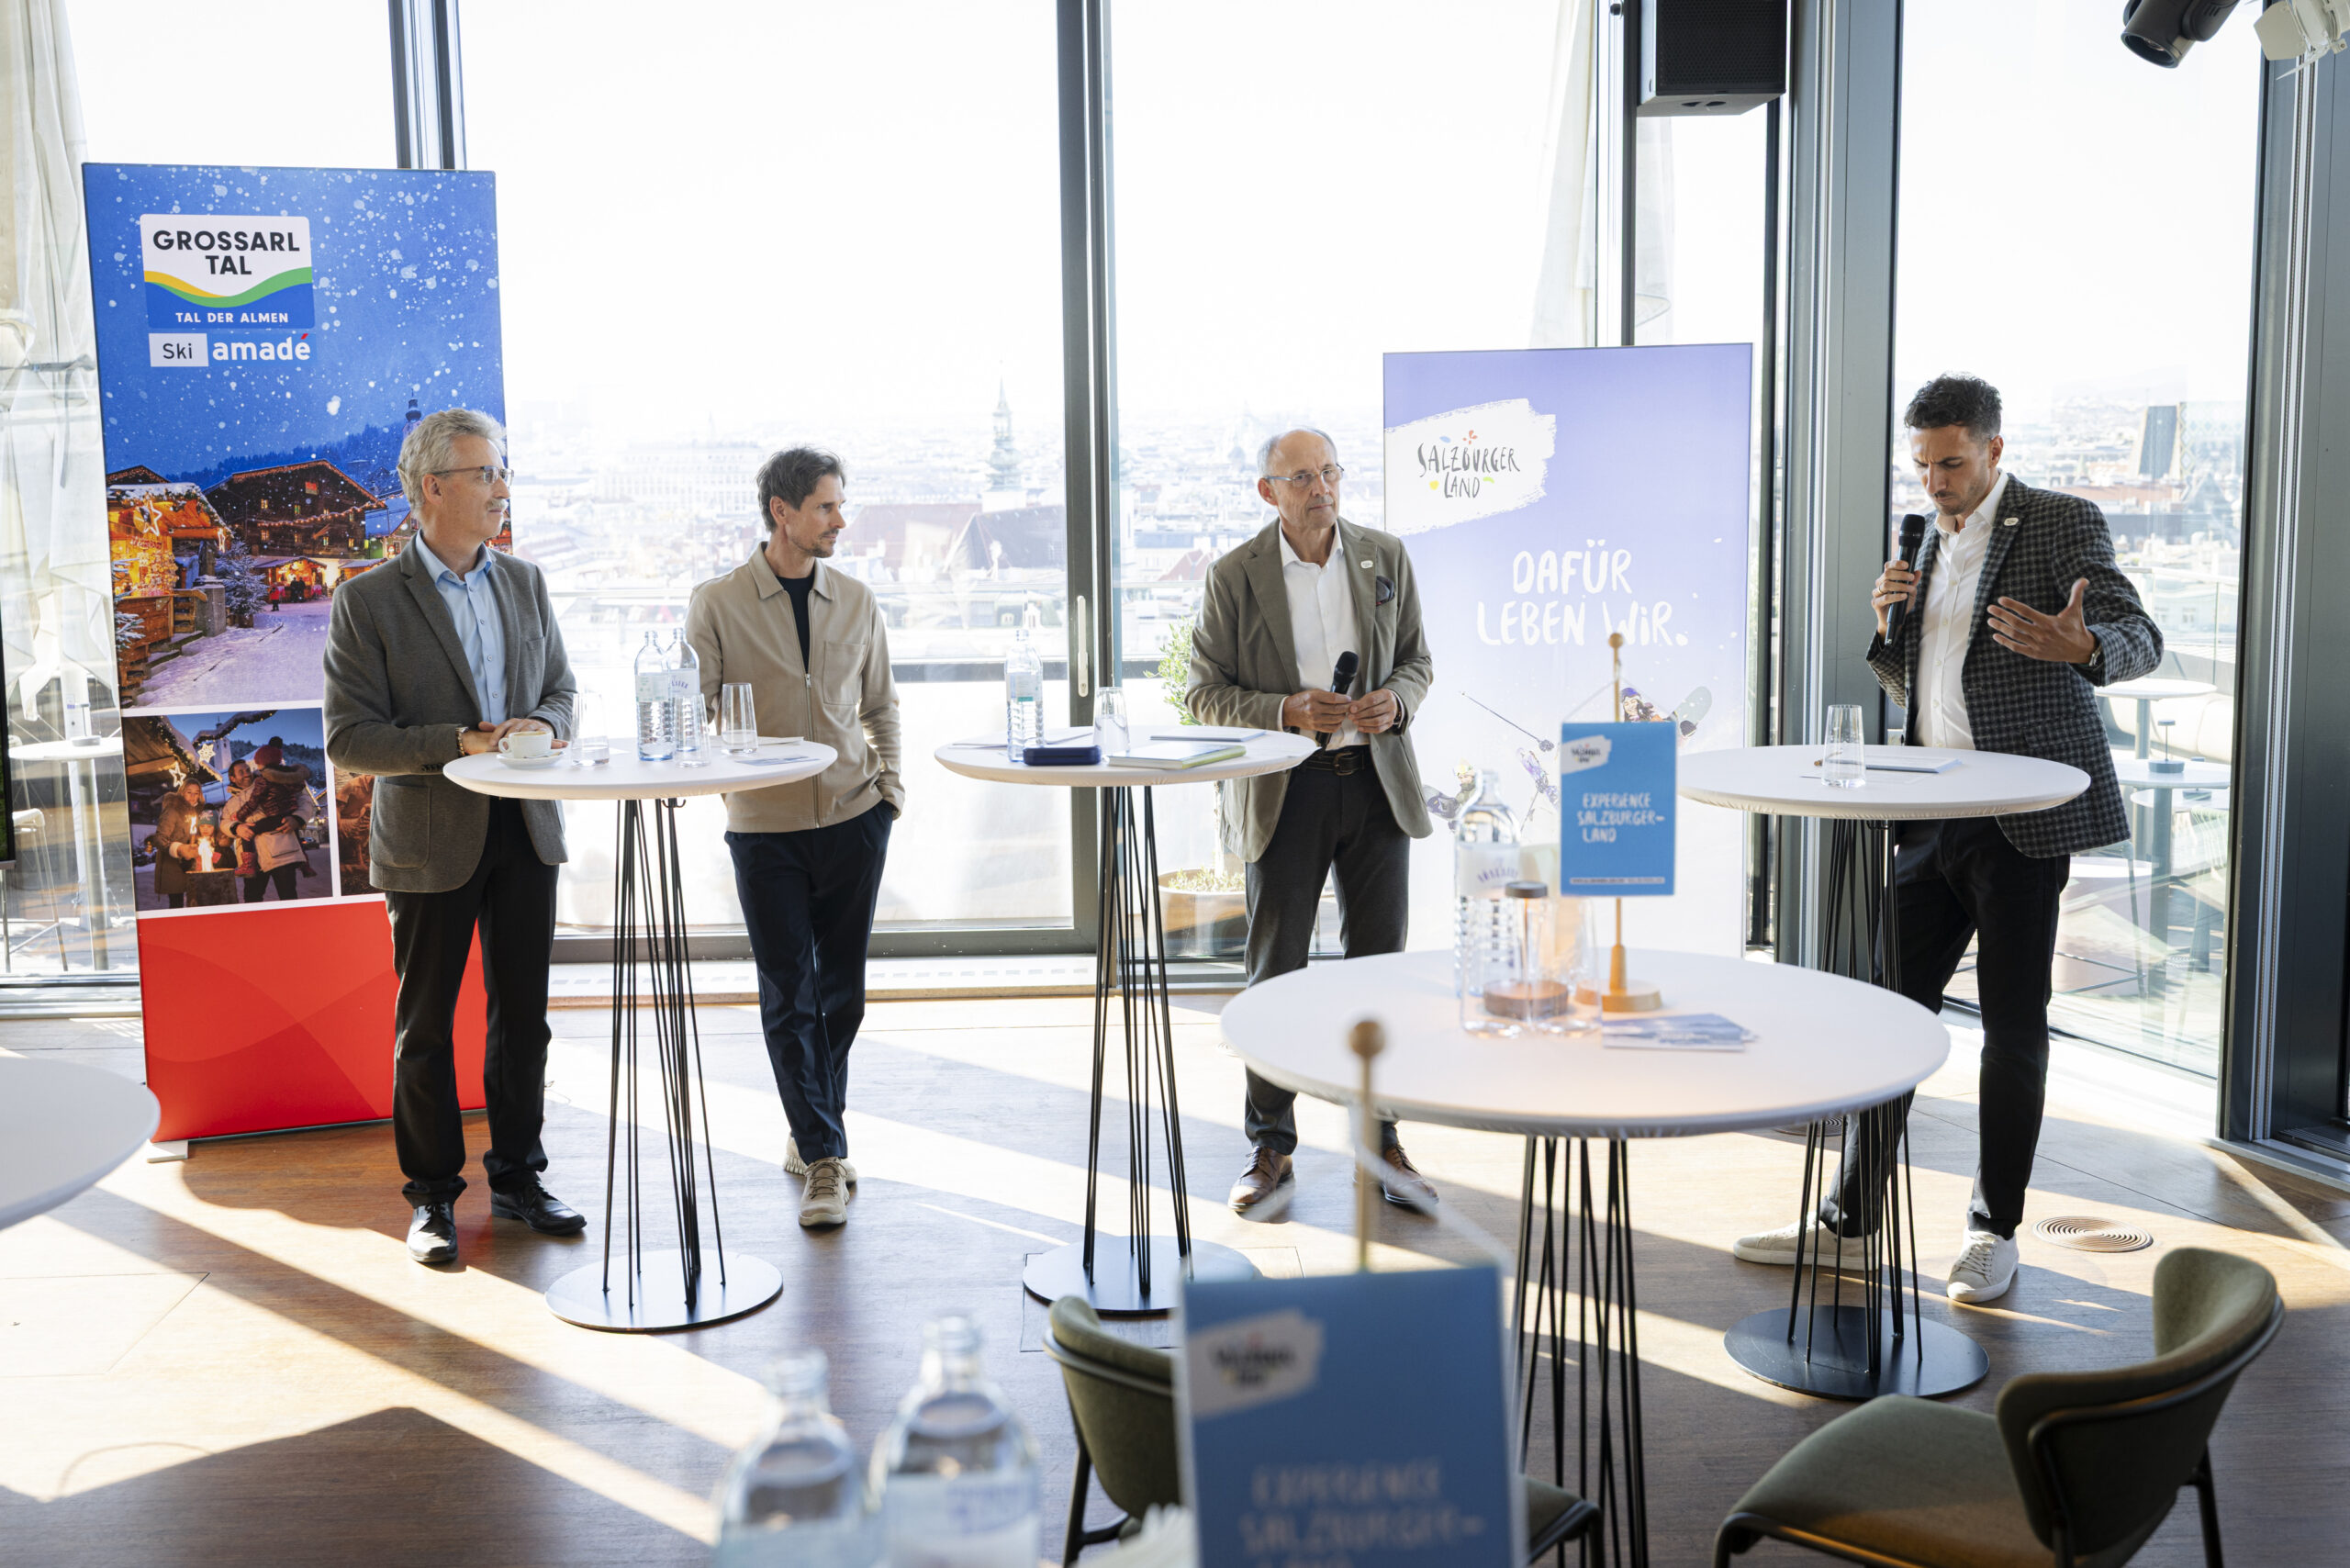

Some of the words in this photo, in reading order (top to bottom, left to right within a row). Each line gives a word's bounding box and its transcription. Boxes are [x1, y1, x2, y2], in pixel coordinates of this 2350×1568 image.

[153, 230, 300, 252] GROSSARL
[205, 255, 252, 275] TAL
[175, 312, 201, 323] TAL
[207, 312, 234, 323] DER
[240, 312, 288, 323] ALMEN
[162, 342, 194, 360] Ski
[212, 333, 311, 361] amadé
[1417, 442, 1521, 477] SALZBURGER
[1444, 472, 1481, 498] LAND
[1513, 539, 1633, 594] DAFÜR
[1477, 600, 1587, 646] LEBEN
[1577, 810, 1665, 826] SALZBURGER-
[1582, 827, 1617, 844] LAND
